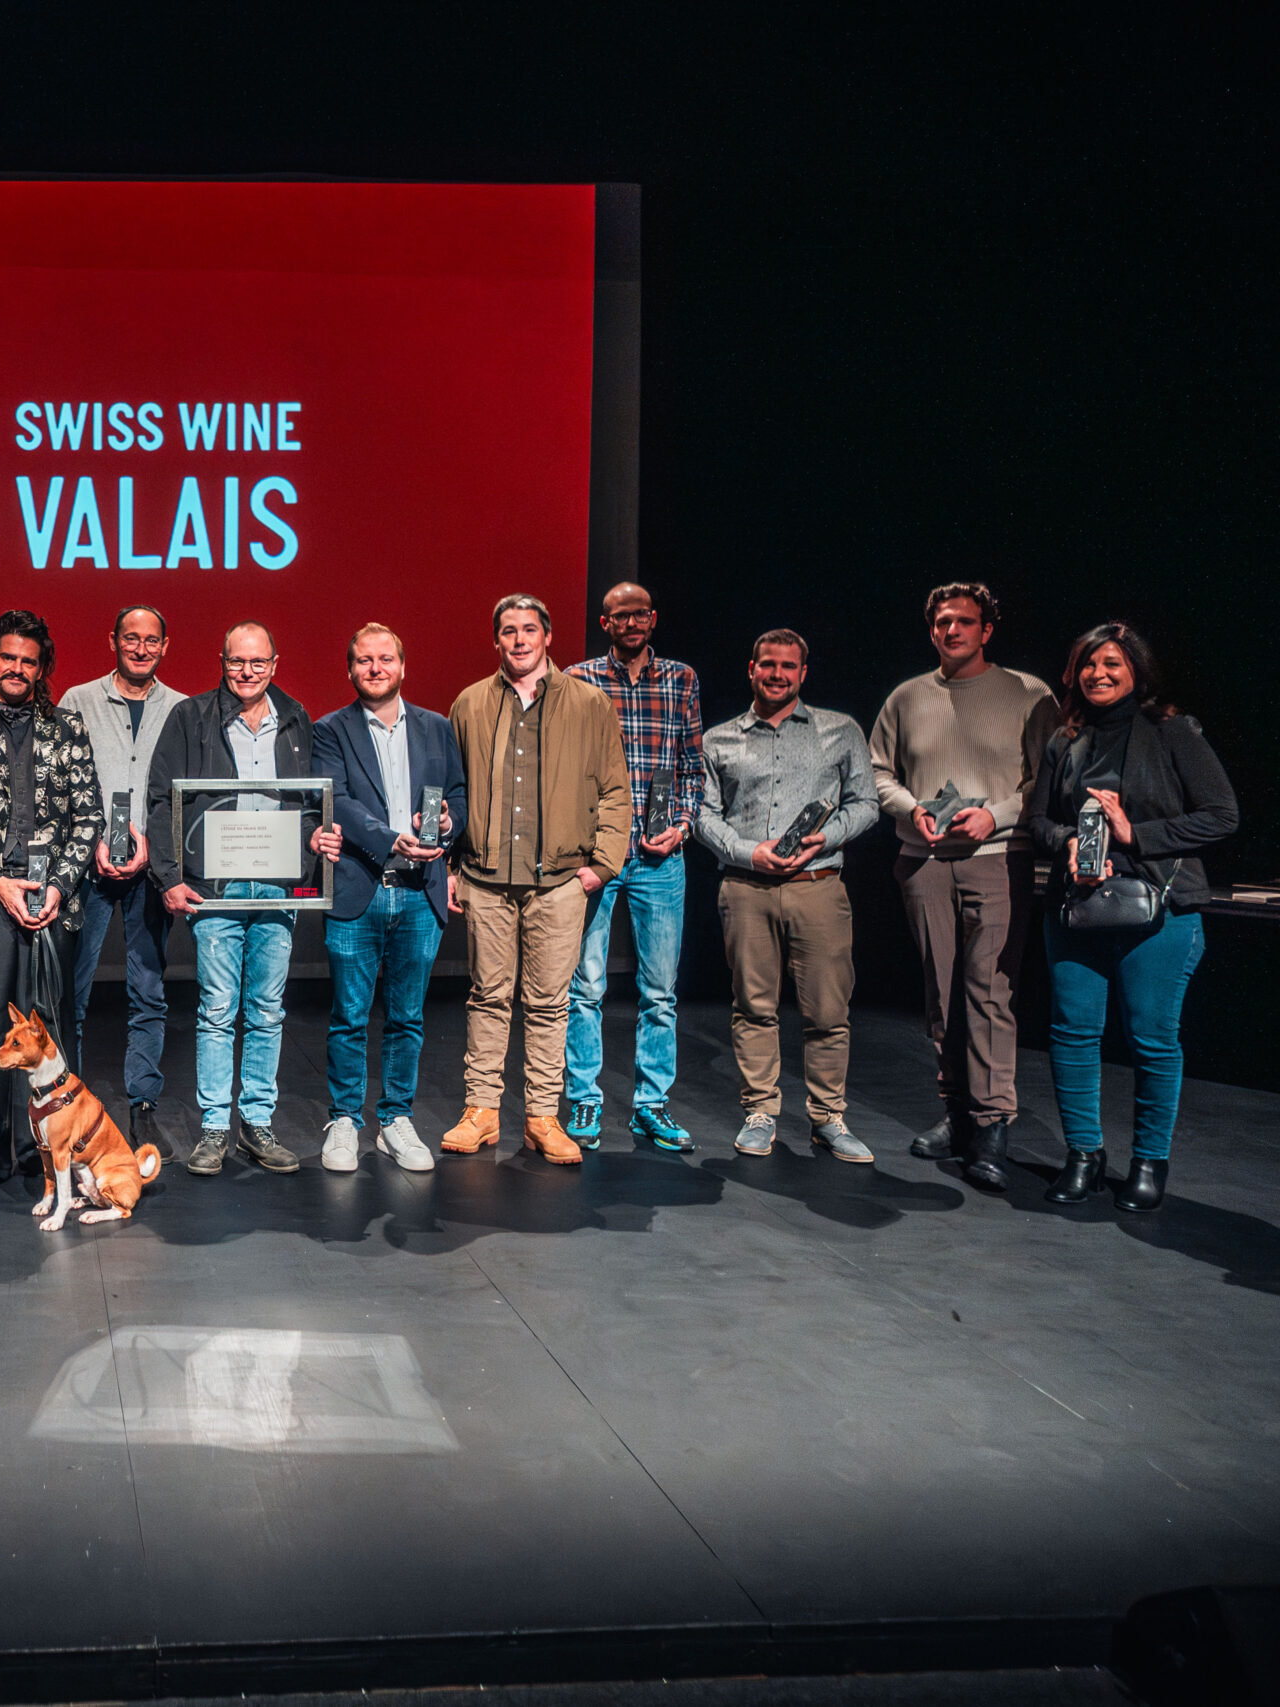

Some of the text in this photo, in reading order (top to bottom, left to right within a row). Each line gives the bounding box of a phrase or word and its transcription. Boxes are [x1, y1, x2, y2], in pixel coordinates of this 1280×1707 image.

[16, 402, 301, 451] SWISS WINE
[16, 476, 298, 570] VALAIS
